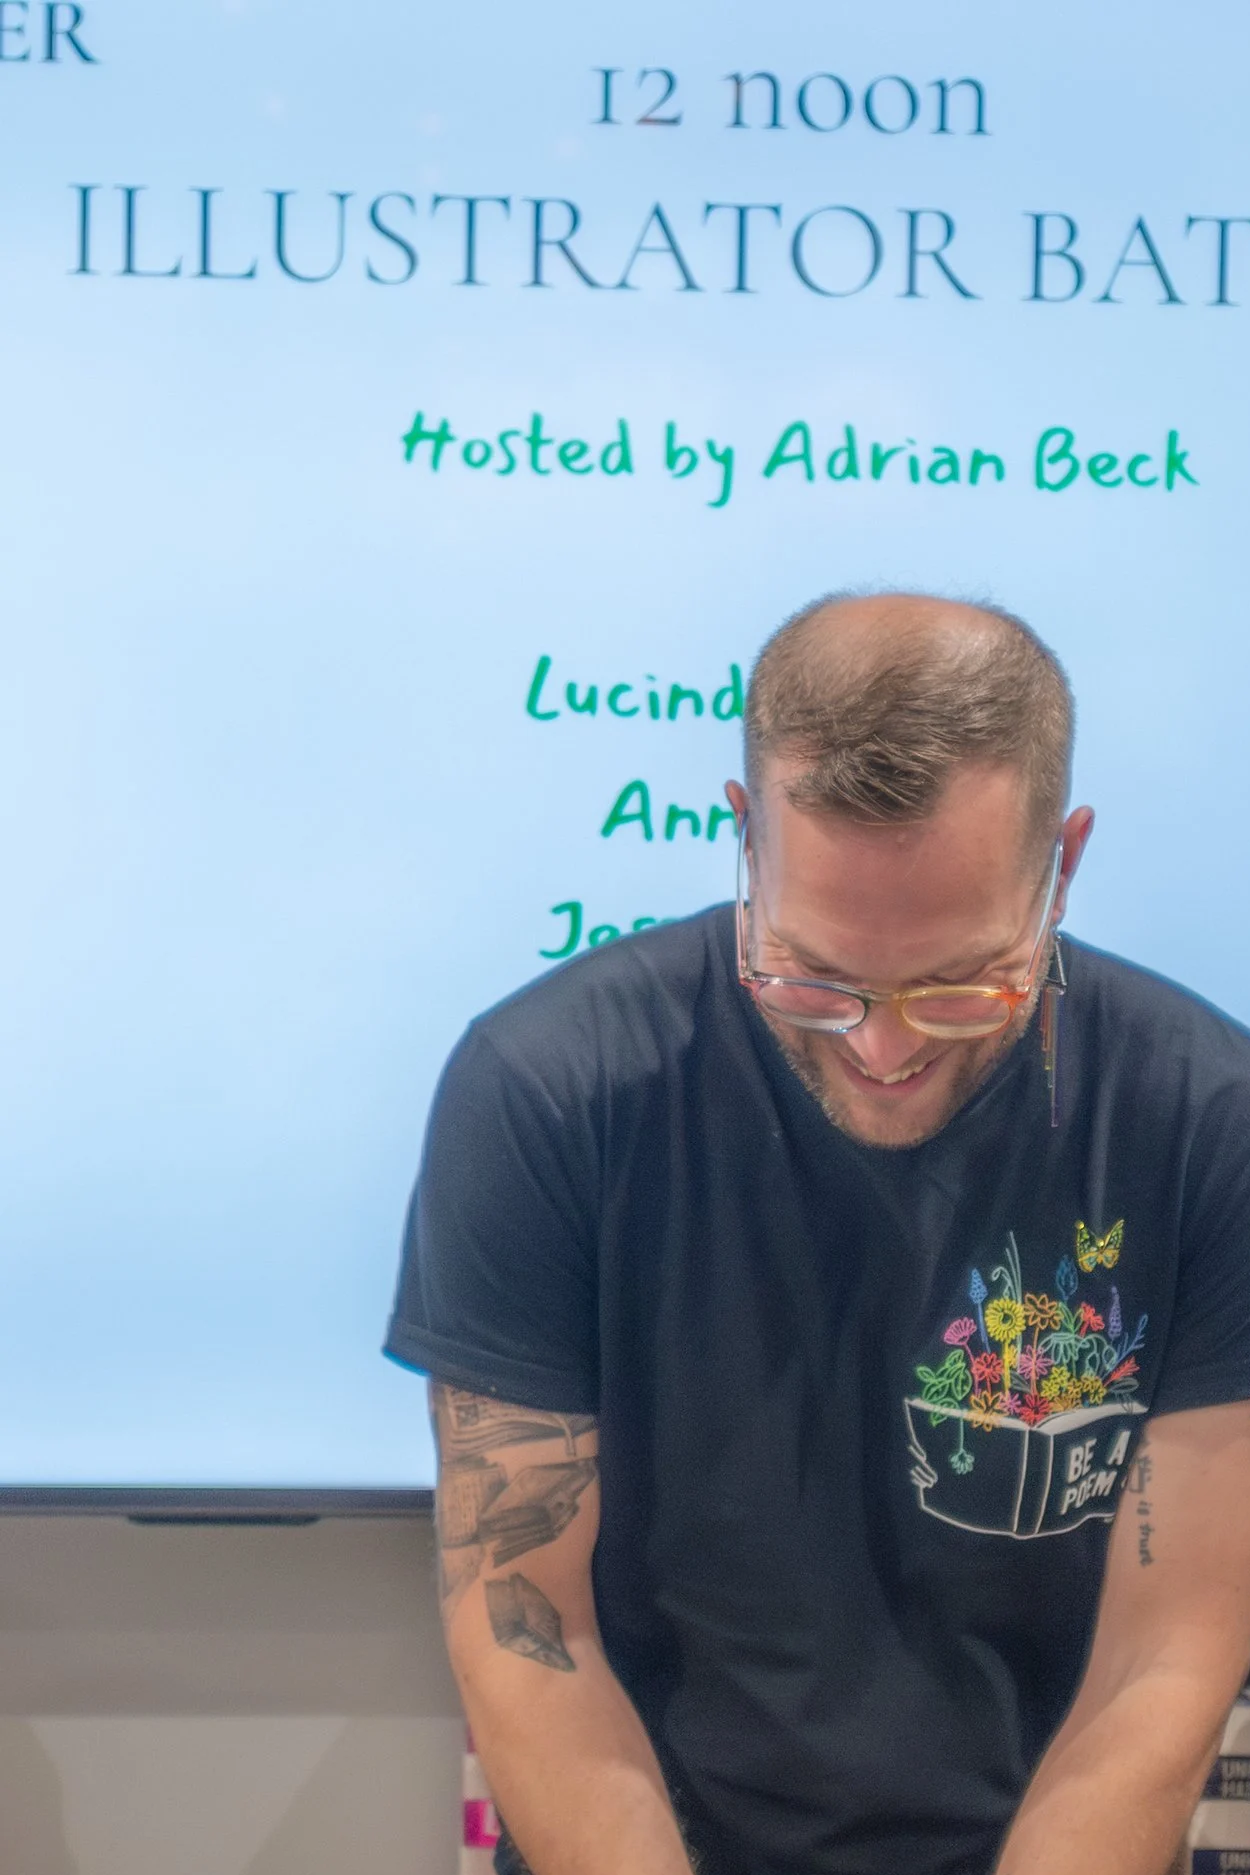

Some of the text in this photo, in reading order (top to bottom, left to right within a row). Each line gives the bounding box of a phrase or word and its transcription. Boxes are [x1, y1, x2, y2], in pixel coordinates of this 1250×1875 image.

[594, 67, 992, 136] 12 noon
[67, 183, 983, 300] ILLUSTRATOR
[400, 410, 1200, 509] Hosted by Adrian Beck
[526, 654, 744, 722] Lucind
[1067, 1438, 1098, 1484] BE
[1107, 1429, 1132, 1466] A
[1059, 1470, 1118, 1516] POEM
